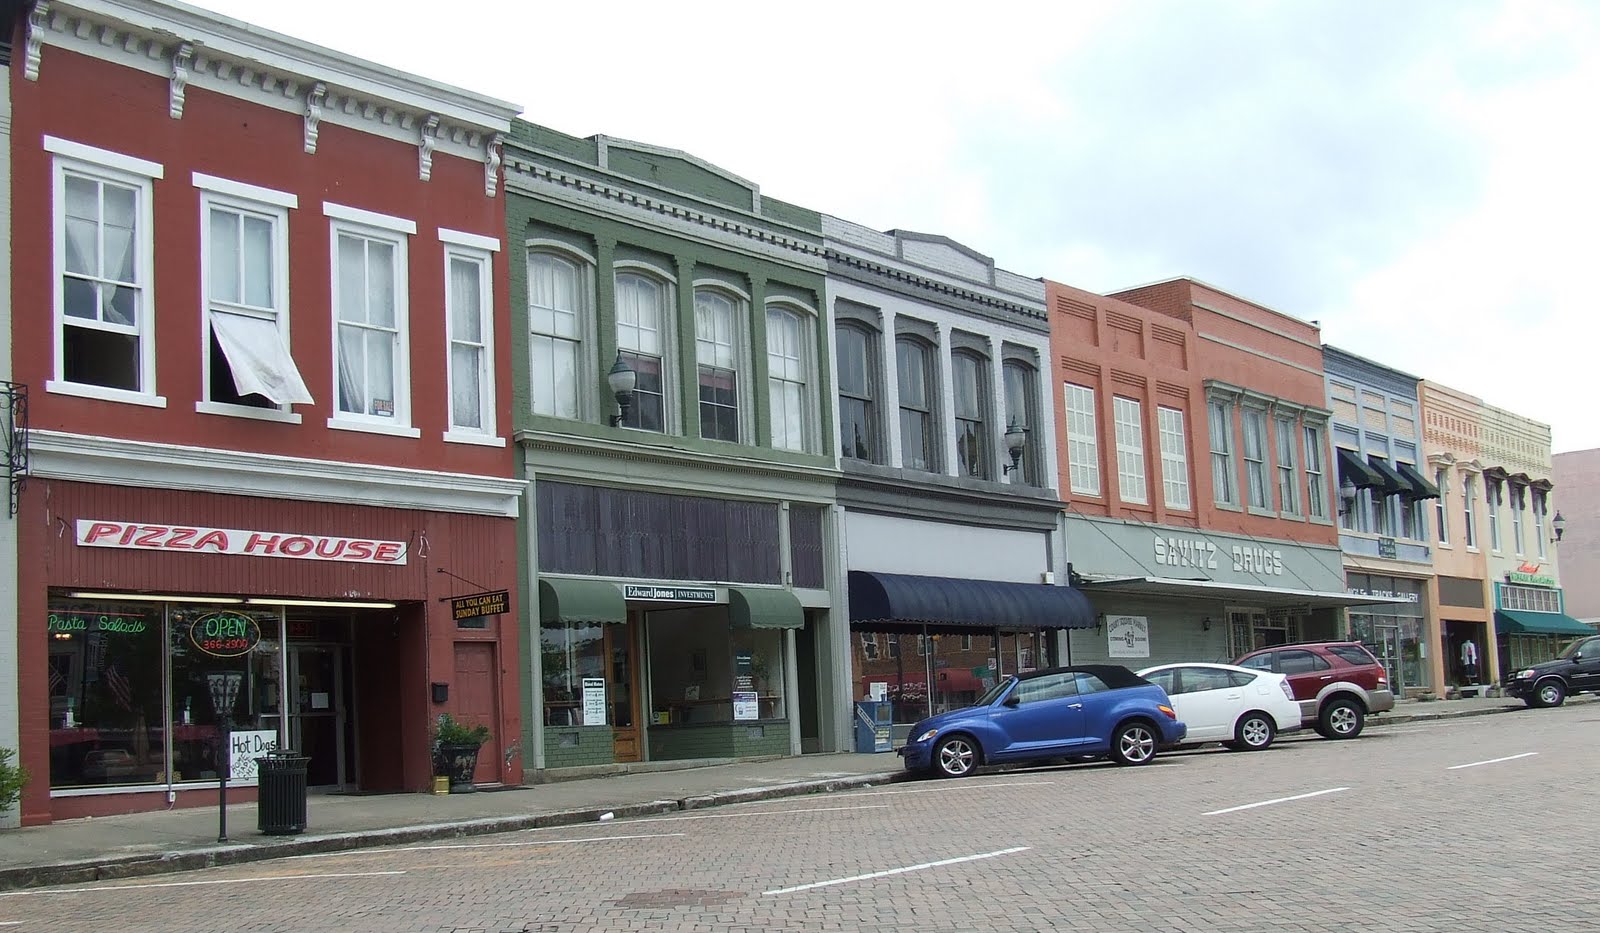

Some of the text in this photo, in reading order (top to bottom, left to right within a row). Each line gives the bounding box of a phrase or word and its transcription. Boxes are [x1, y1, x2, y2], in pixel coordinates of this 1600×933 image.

[84, 523, 402, 562] PIZZA HOUSE
[1154, 536, 1282, 576] SAVITZ DRUGS
[456, 594, 503, 610] ALL YOU CAN EAT
[677, 590, 714, 599] INVESTMENTS
[456, 603, 504, 619] SUNDAY BUFFET
[48, 614, 145, 633] Pasta Salads
[206, 618, 247, 637] OPEN
[232, 734, 276, 754] Hot Dogs
